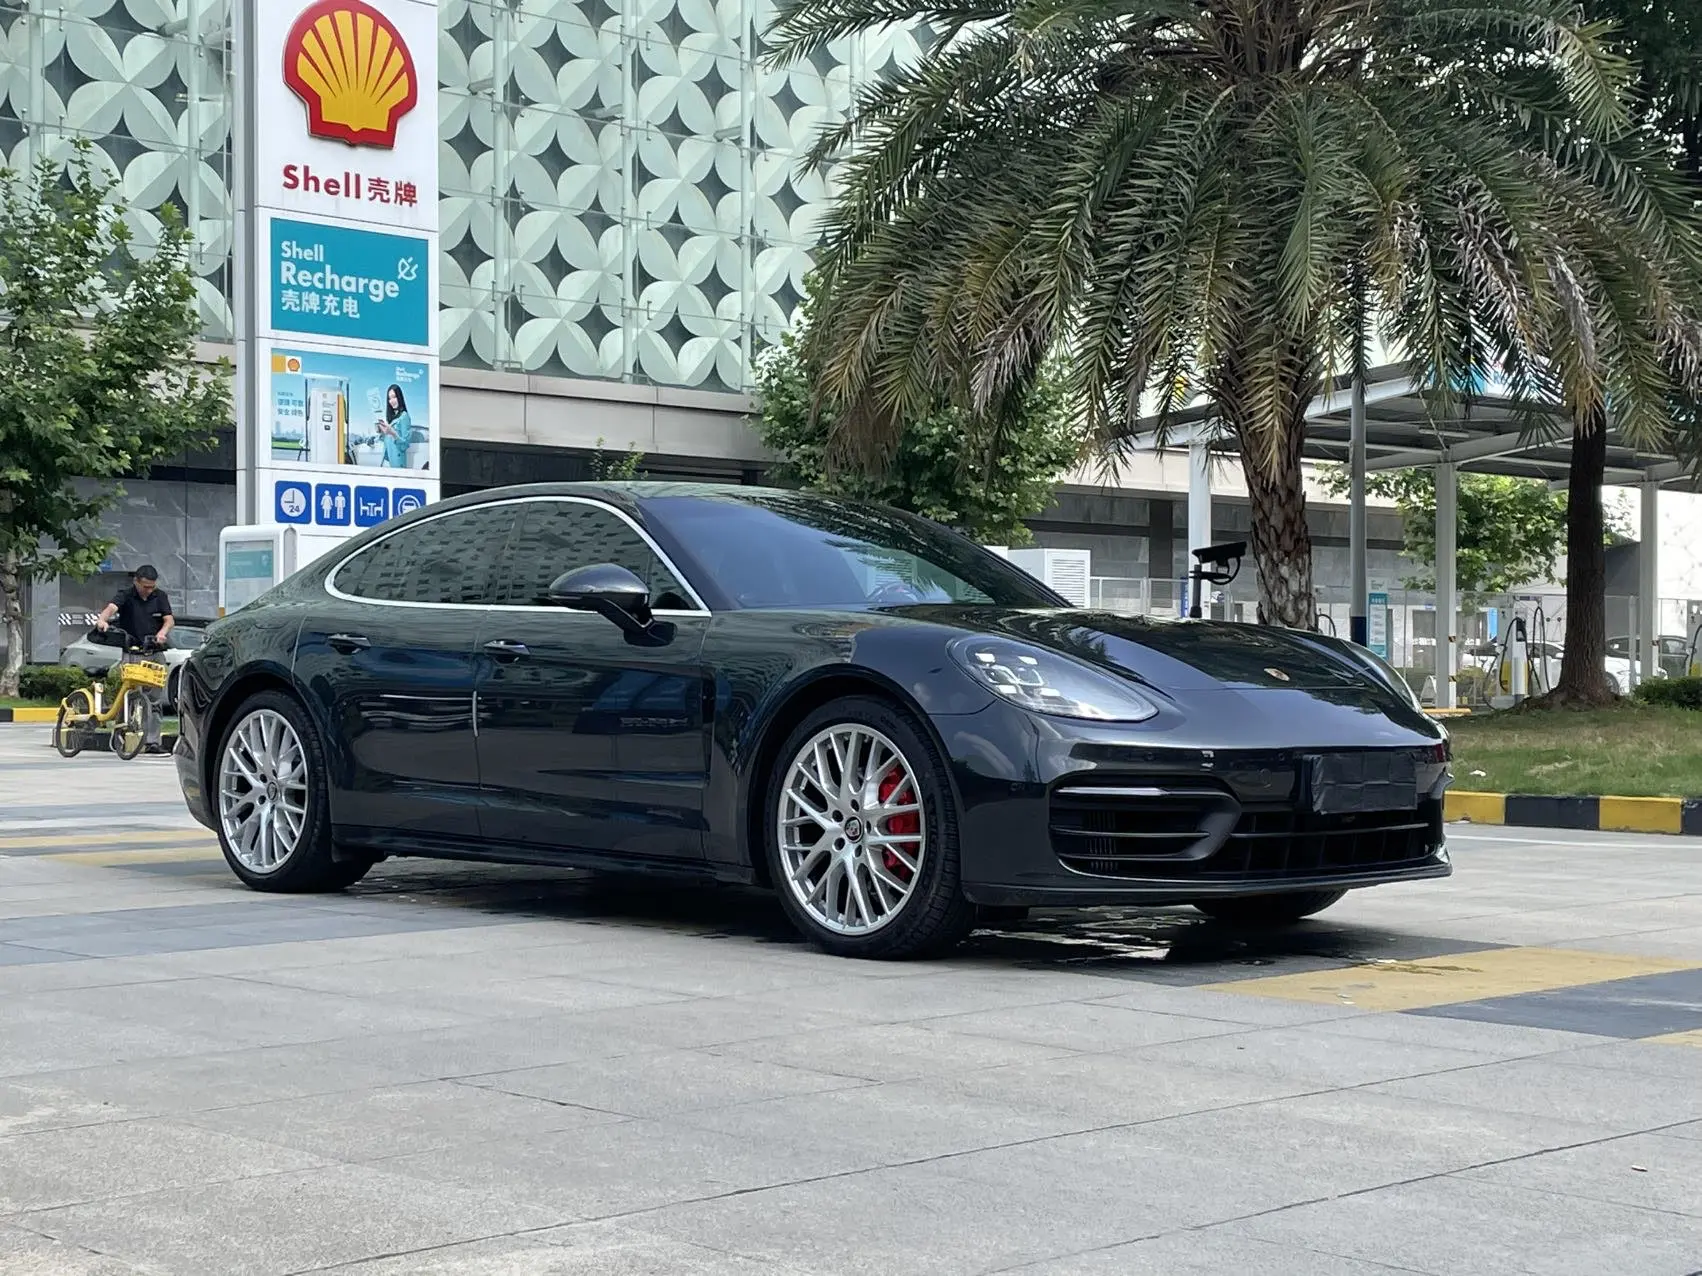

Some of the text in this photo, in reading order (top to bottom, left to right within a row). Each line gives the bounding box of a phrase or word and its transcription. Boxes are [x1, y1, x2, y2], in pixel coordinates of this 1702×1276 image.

[282, 164, 418, 207] Shell 壳牌
[281, 241, 324, 262] Shell
[281, 261, 400, 303] Recharge
[281, 289, 360, 319] 壳牌充电
[288, 504, 300, 514] 24
